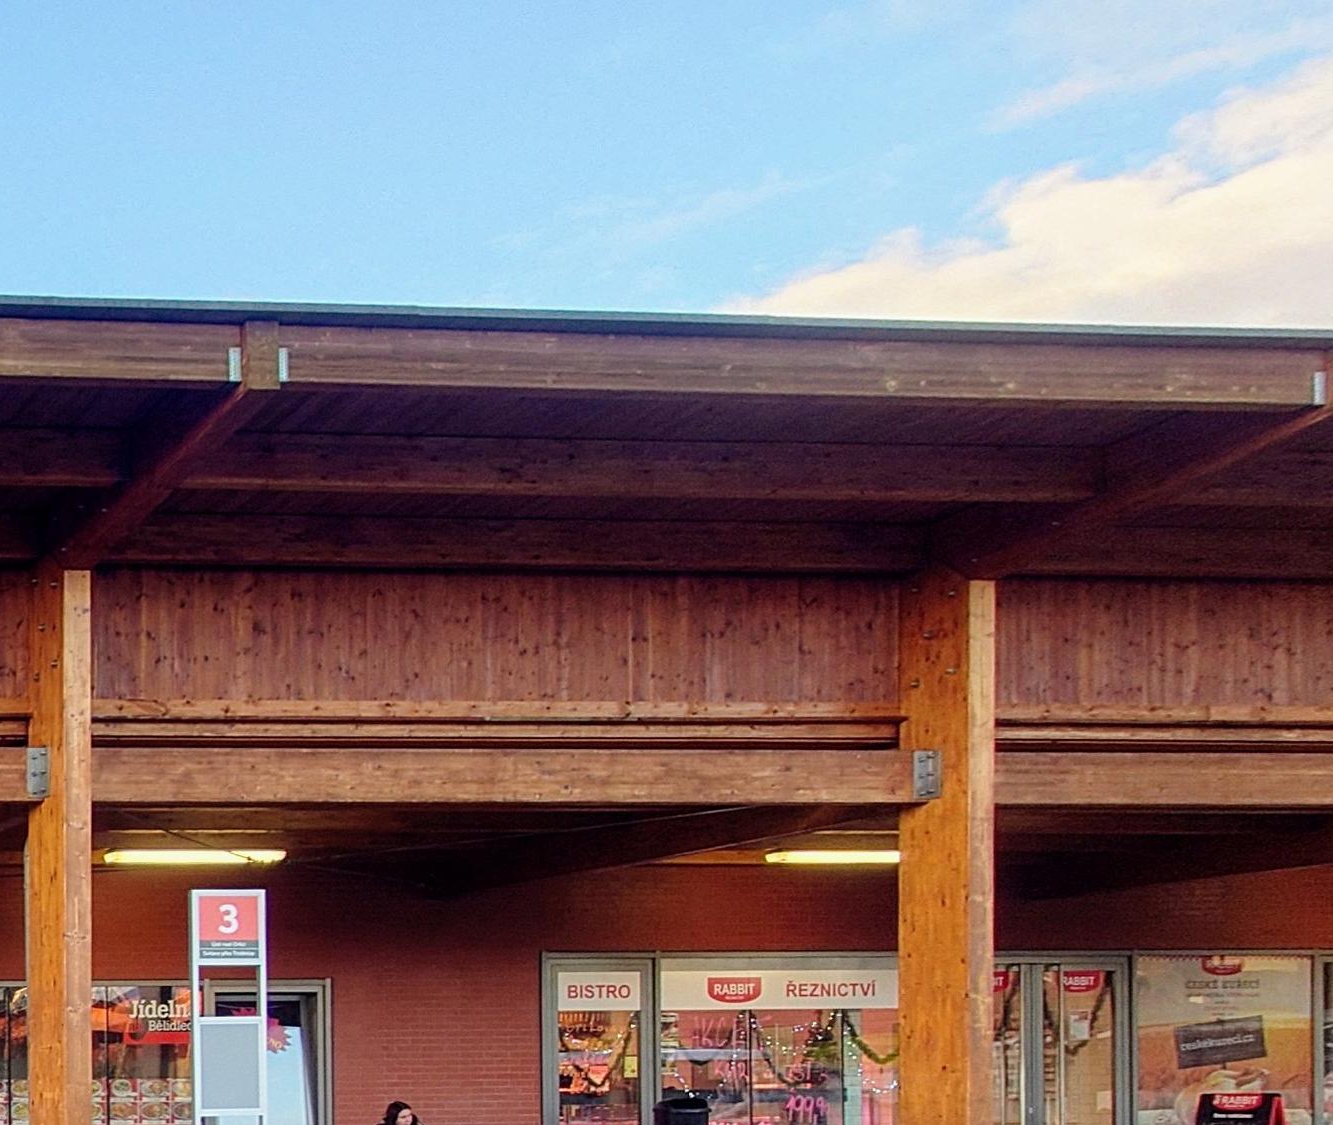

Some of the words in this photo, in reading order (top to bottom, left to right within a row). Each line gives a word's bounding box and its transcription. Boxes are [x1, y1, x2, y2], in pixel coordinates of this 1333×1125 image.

[217, 903, 239, 934] 3
[567, 984, 631, 999] BISTRO
[714, 983, 755, 995] RABBIT
[786, 980, 876, 998] ŘEZNICTVÍ
[129, 999, 192, 1019] Jídeln
[148, 1020, 192, 1032] Bělidlec
